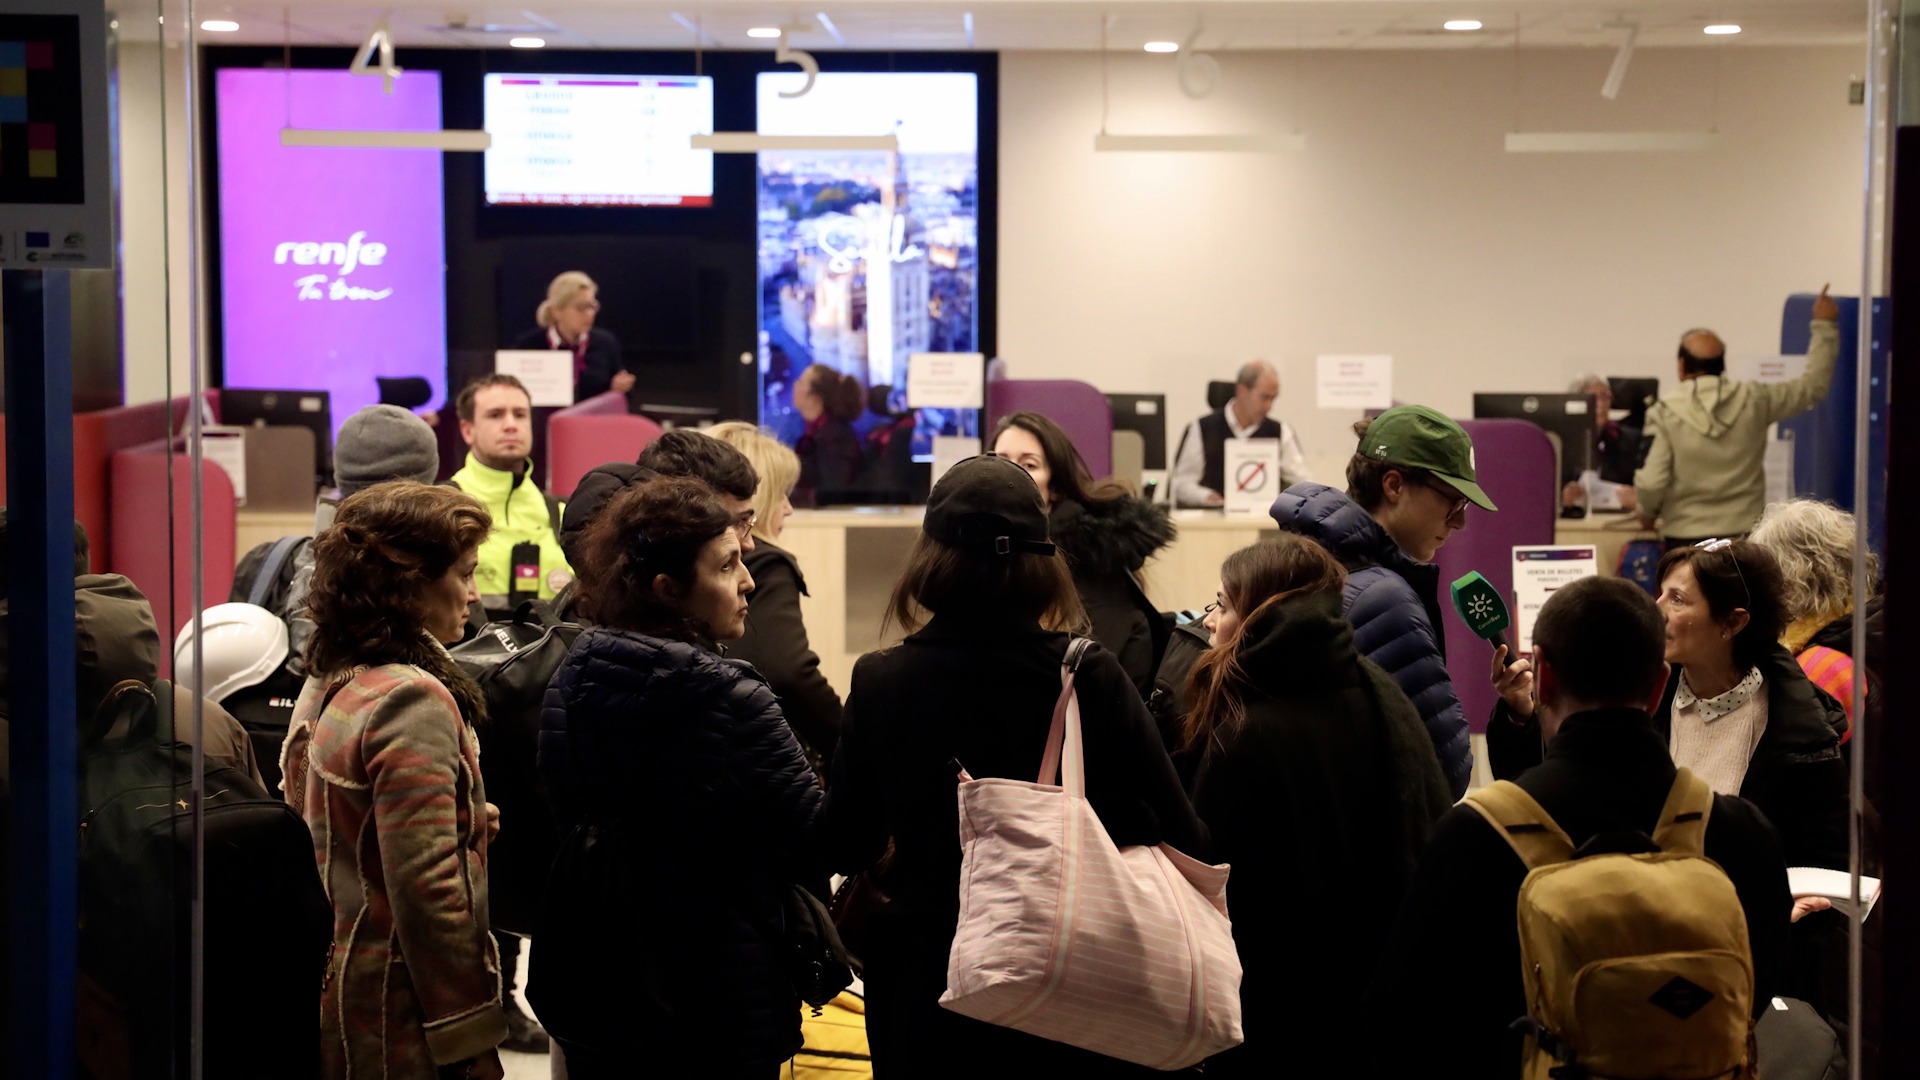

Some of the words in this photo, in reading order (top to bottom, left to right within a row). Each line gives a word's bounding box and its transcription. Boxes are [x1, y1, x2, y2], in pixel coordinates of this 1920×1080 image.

[349, 25, 404, 95] 4
[775, 23, 820, 98] 5
[1177, 26, 1220, 100] 6
[1601, 20, 1639, 100] 7
[273, 230, 388, 276] renfe
